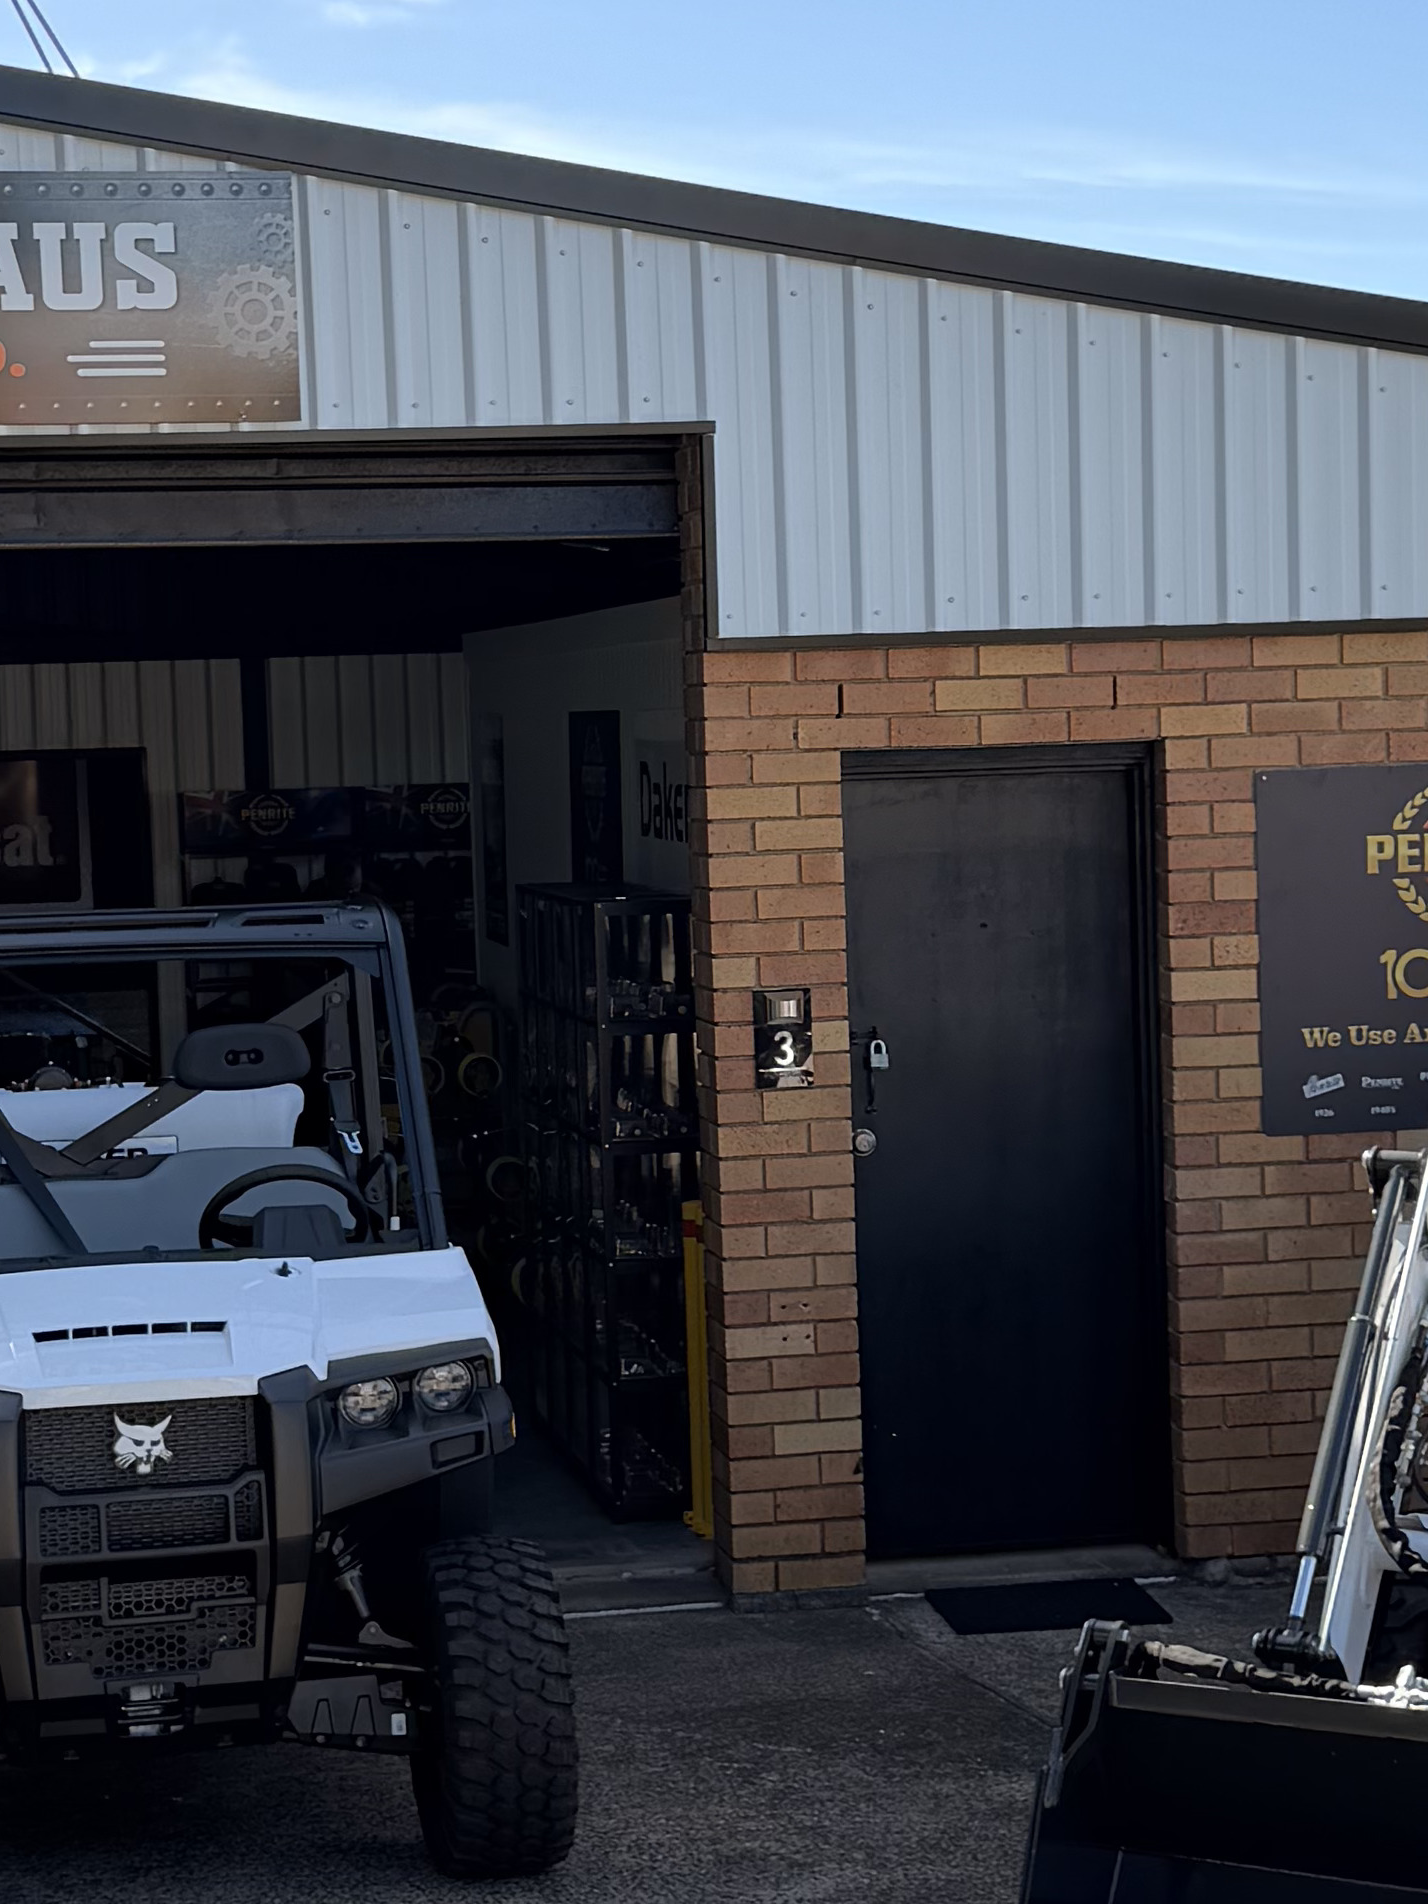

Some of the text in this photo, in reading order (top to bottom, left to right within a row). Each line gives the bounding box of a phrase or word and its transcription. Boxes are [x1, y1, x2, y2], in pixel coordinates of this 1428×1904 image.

[240, 806, 296, 822] PENRITE
[773, 1030, 795, 1066] 3
[1302, 1027, 1342, 1048] We
[1348, 1025, 1397, 1046] Use
